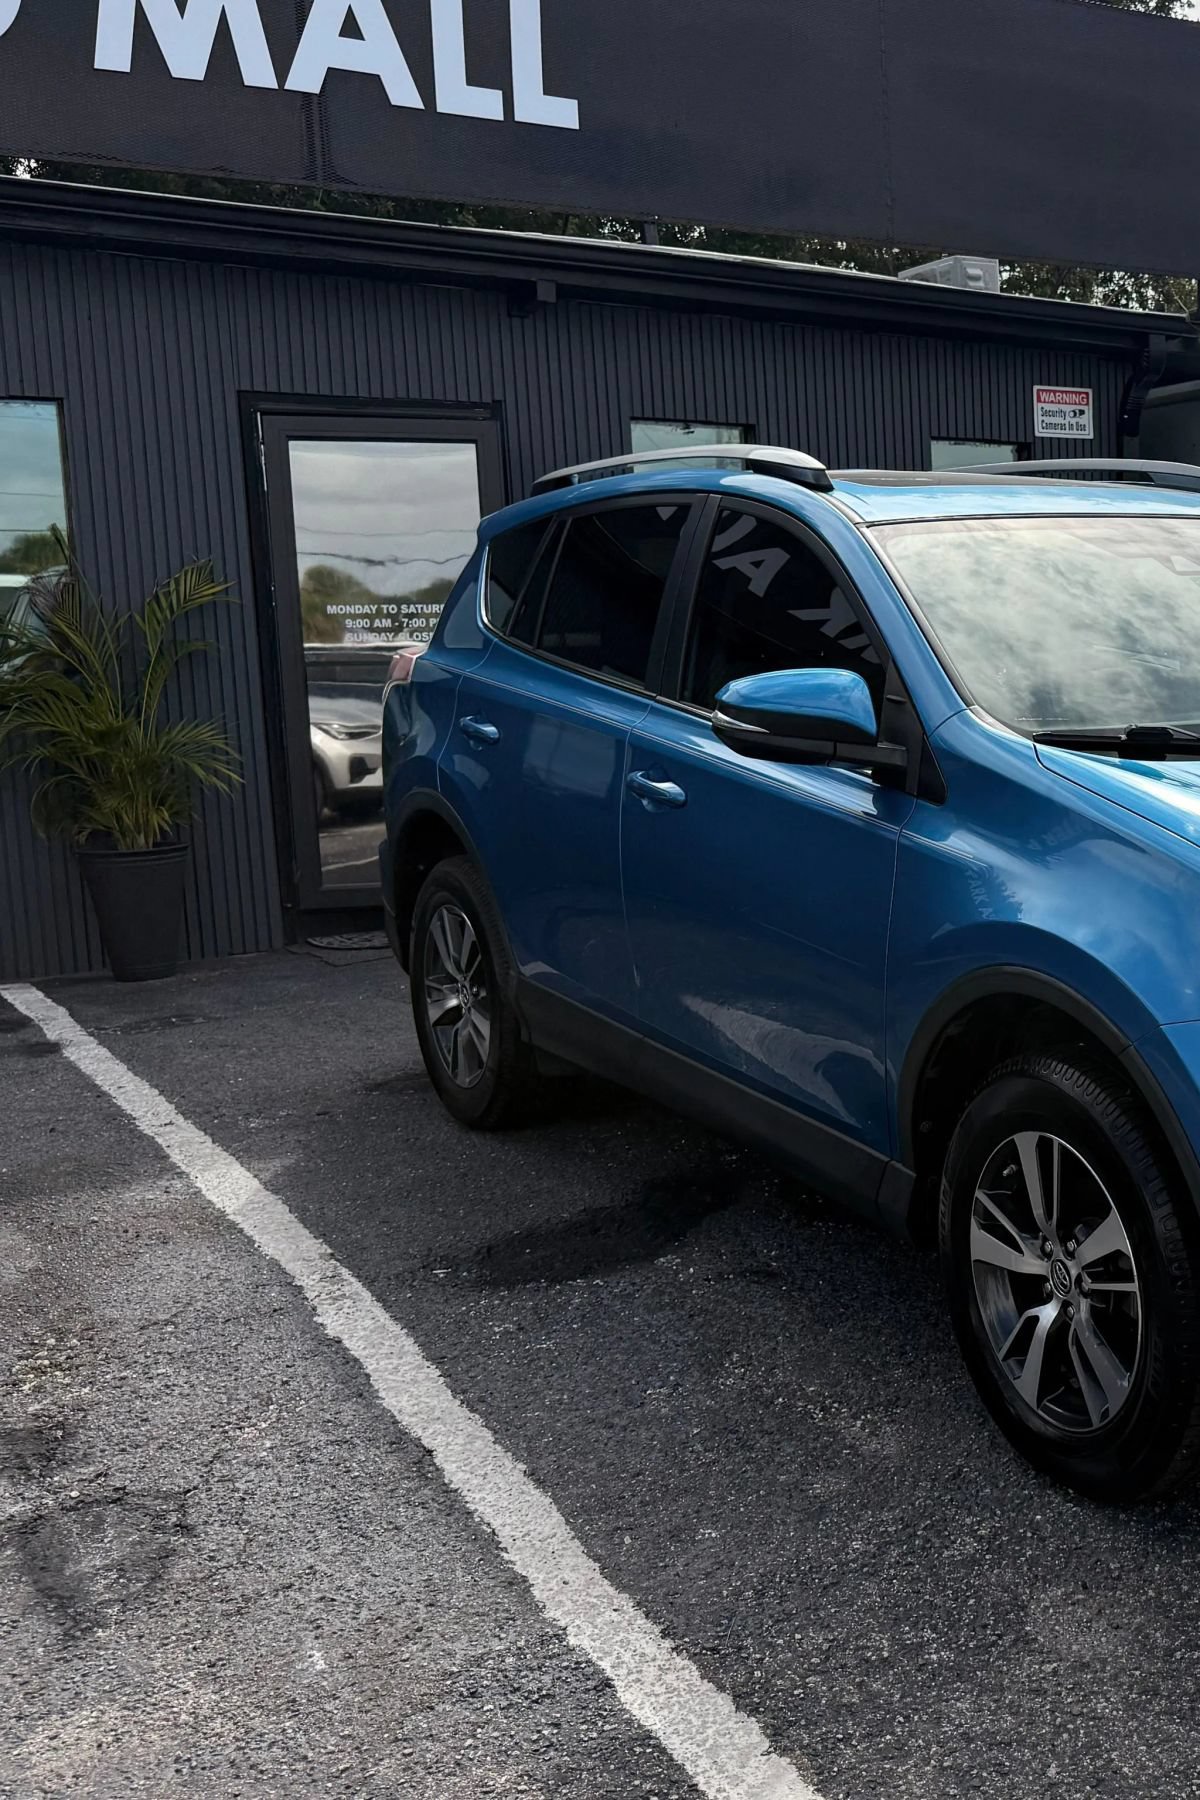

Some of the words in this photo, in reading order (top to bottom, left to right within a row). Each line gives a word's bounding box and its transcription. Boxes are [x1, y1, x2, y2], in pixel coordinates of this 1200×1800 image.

[94, 0, 580, 130] MALL
[1040, 391, 1087, 404] WARNING
[1041, 407, 1067, 420] Security
[1041, 419, 1067, 431] Cameras
[1068, 421, 1075, 431] In
[1075, 421, 1087, 432] Use
[326, 604, 378, 614] MONDAY
[380, 604, 398, 614] TO
[345, 618, 370, 628] 9:00
[373, 618, 392, 628] AM
[401, 618, 426, 628] 7:00
[429, 618, 440, 628] P
[345, 632, 395, 642] SUNDAY
